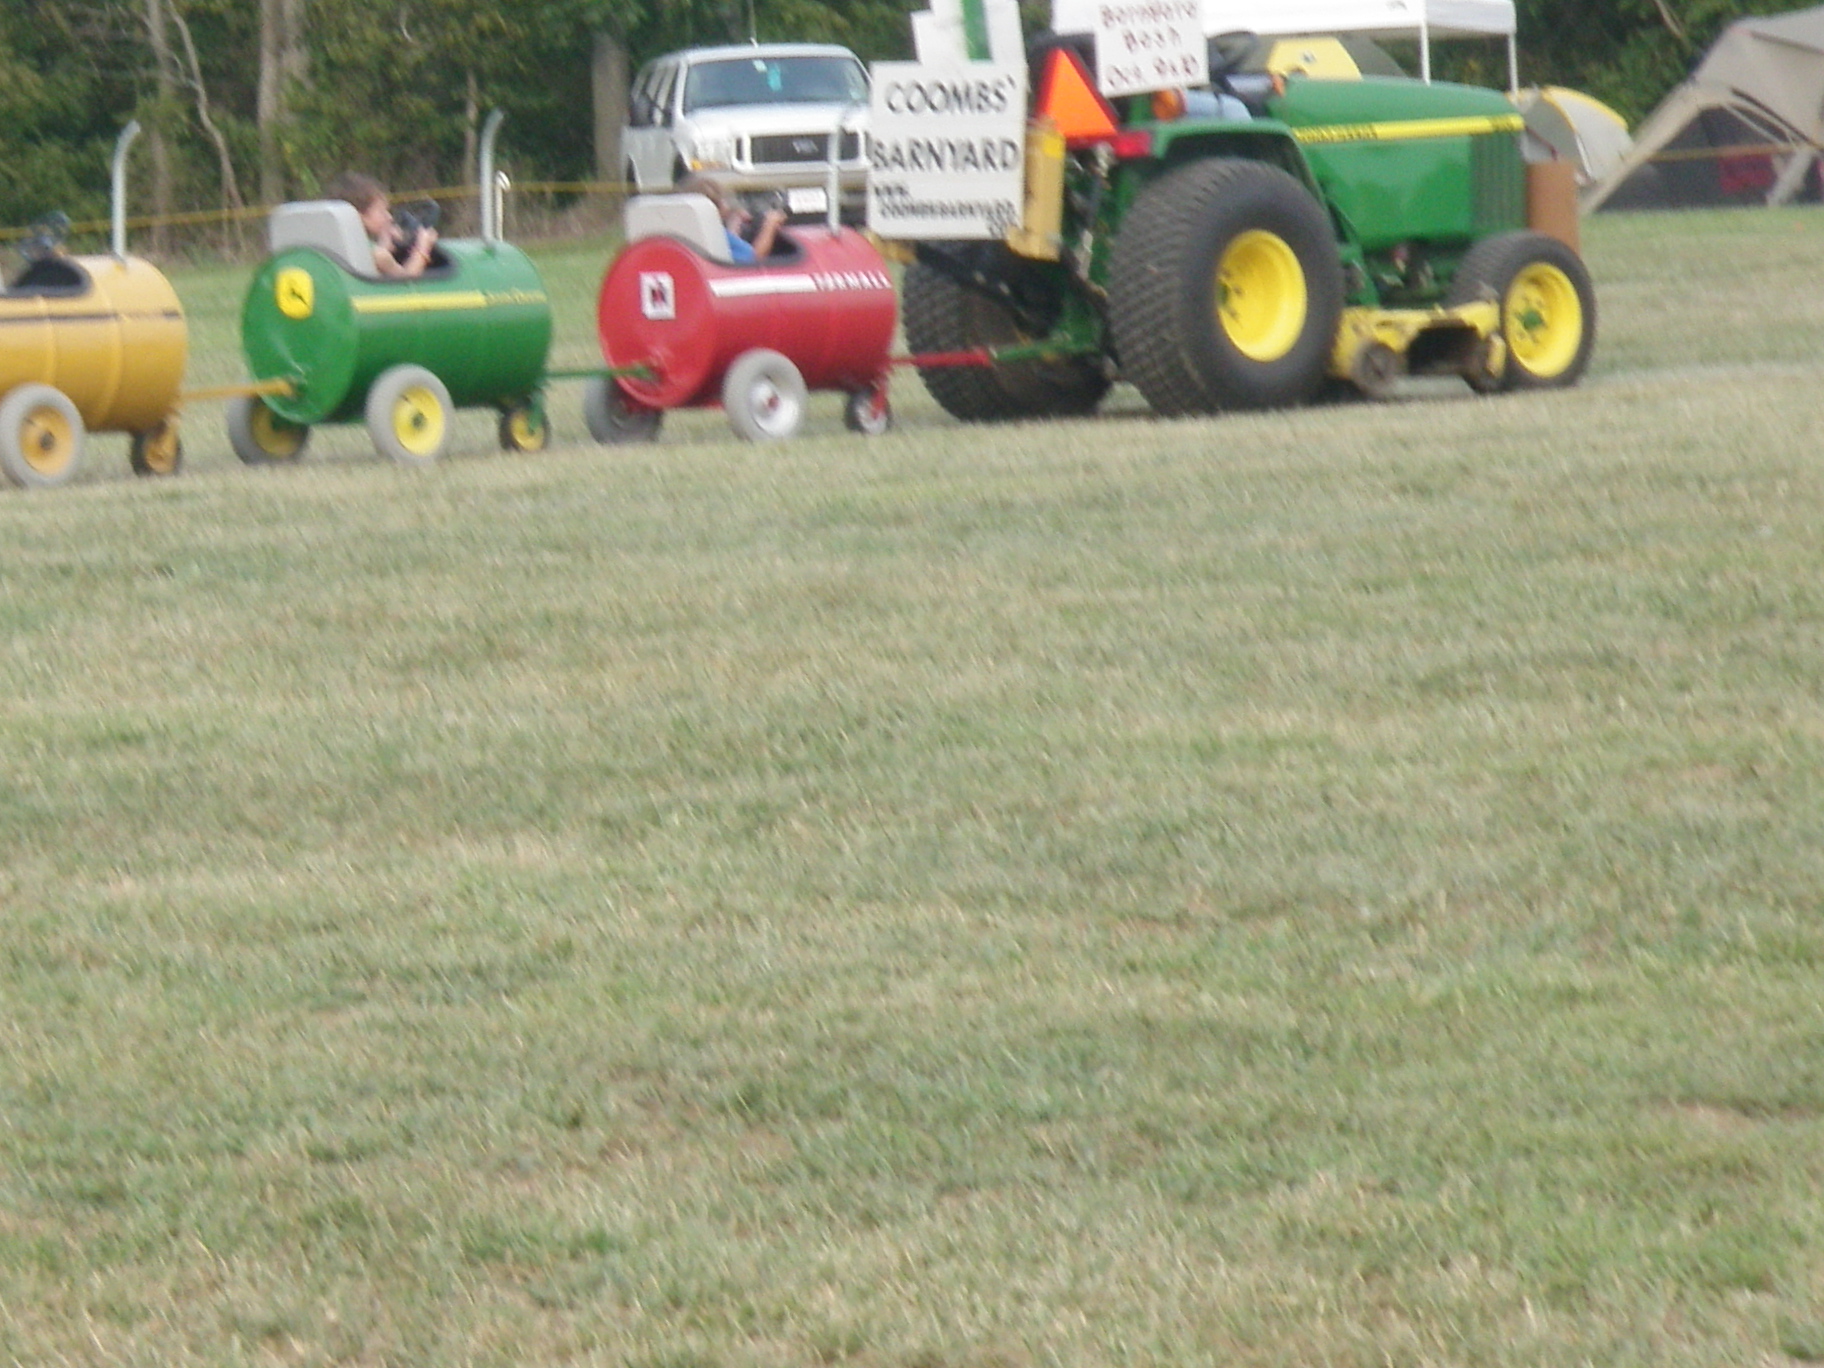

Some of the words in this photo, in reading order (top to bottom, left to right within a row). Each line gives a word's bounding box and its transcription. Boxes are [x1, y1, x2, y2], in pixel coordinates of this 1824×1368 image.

[886, 75, 1016, 113] COOMBS'
[874, 136, 1020, 171] BARNYARD
[809, 270, 893, 292] FARMALL
